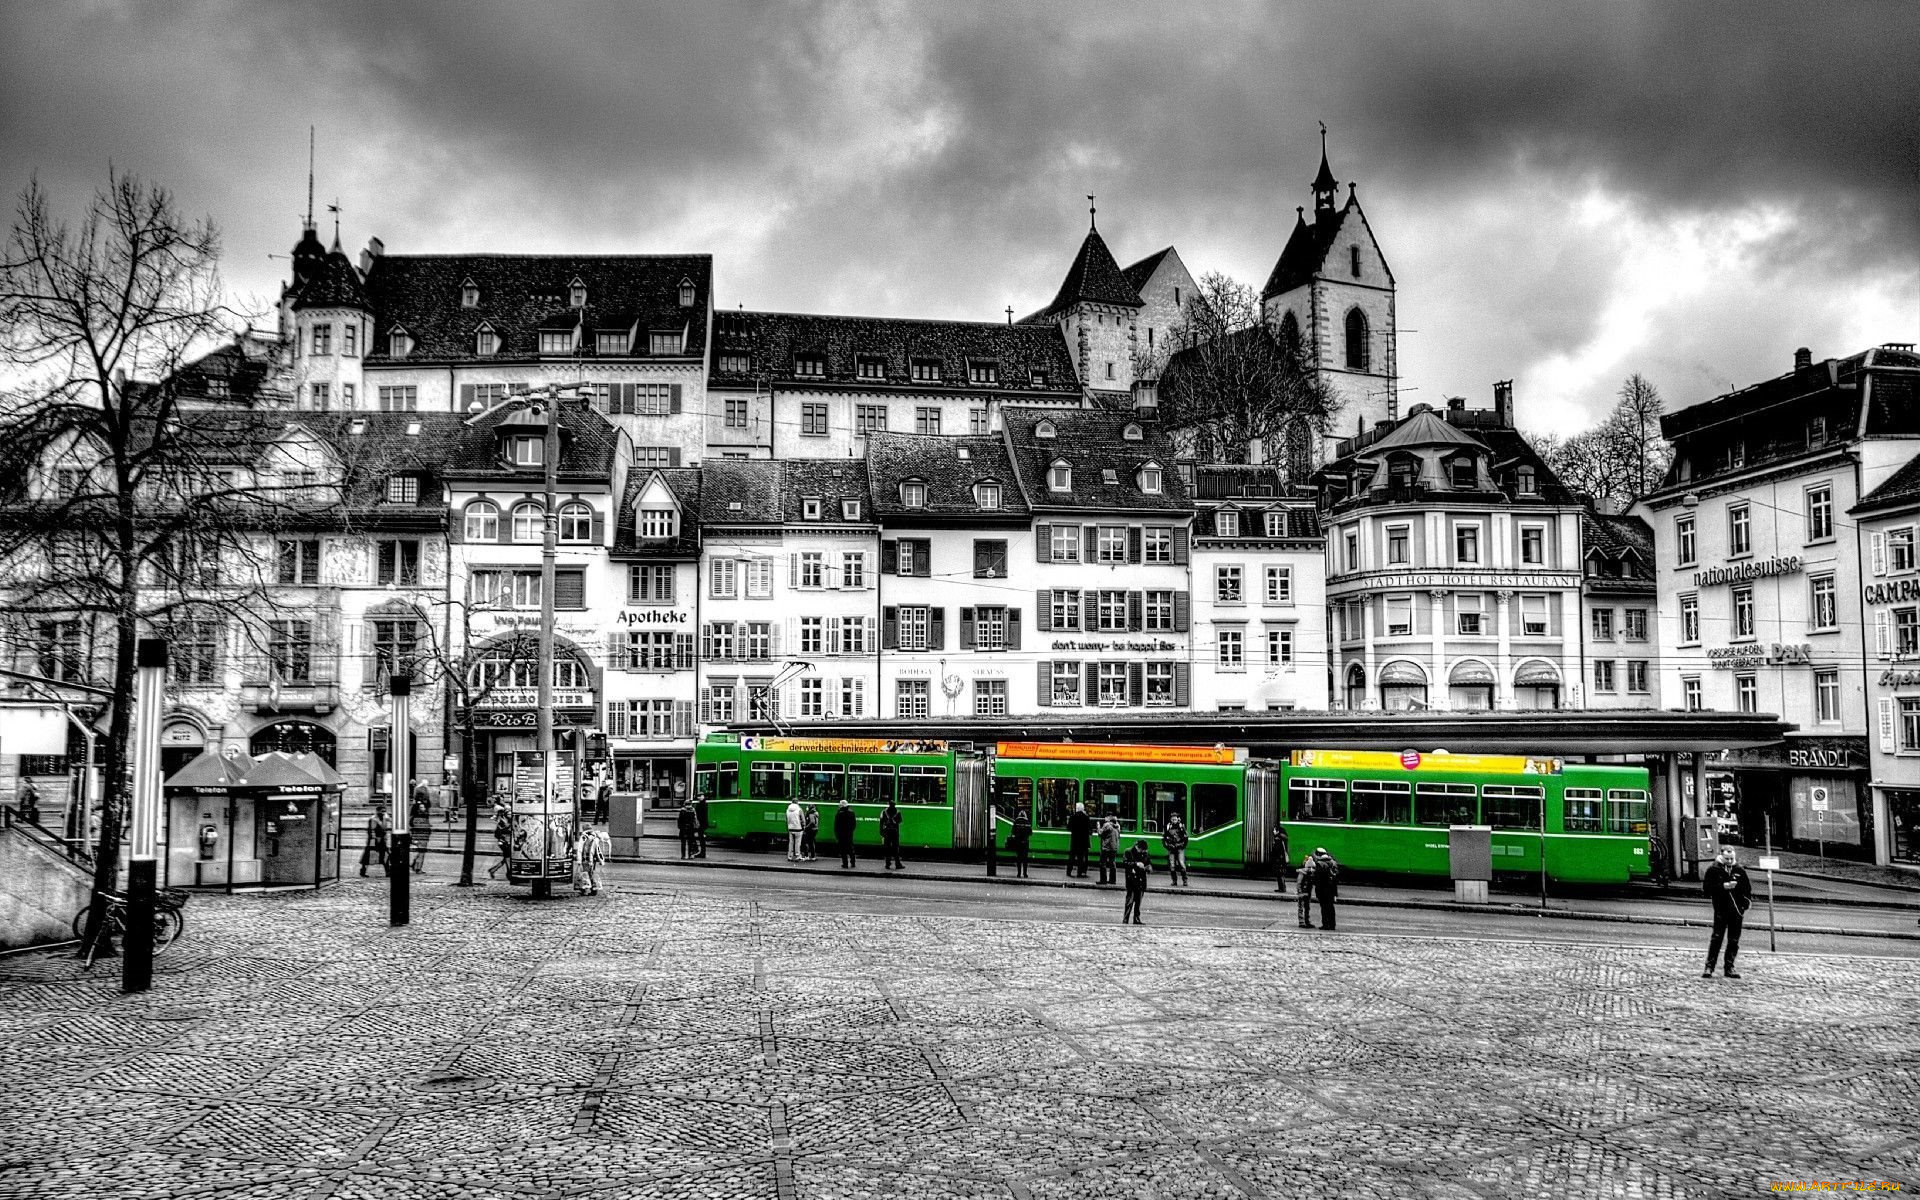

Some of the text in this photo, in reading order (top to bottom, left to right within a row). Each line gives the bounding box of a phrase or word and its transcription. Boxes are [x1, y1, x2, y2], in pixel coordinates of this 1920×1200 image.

[1364, 575, 1579, 588] STADTHOF HOTEL RESTAURANT
[616, 609, 687, 627] Apotheke
[1112, 640, 1126, 651] be
[491, 712, 521, 726] Rio
[789, 743, 879, 753] derwerbetechniker.ch
[193, 786, 228, 794] Telefon
[279, 785, 322, 793] Telefon
